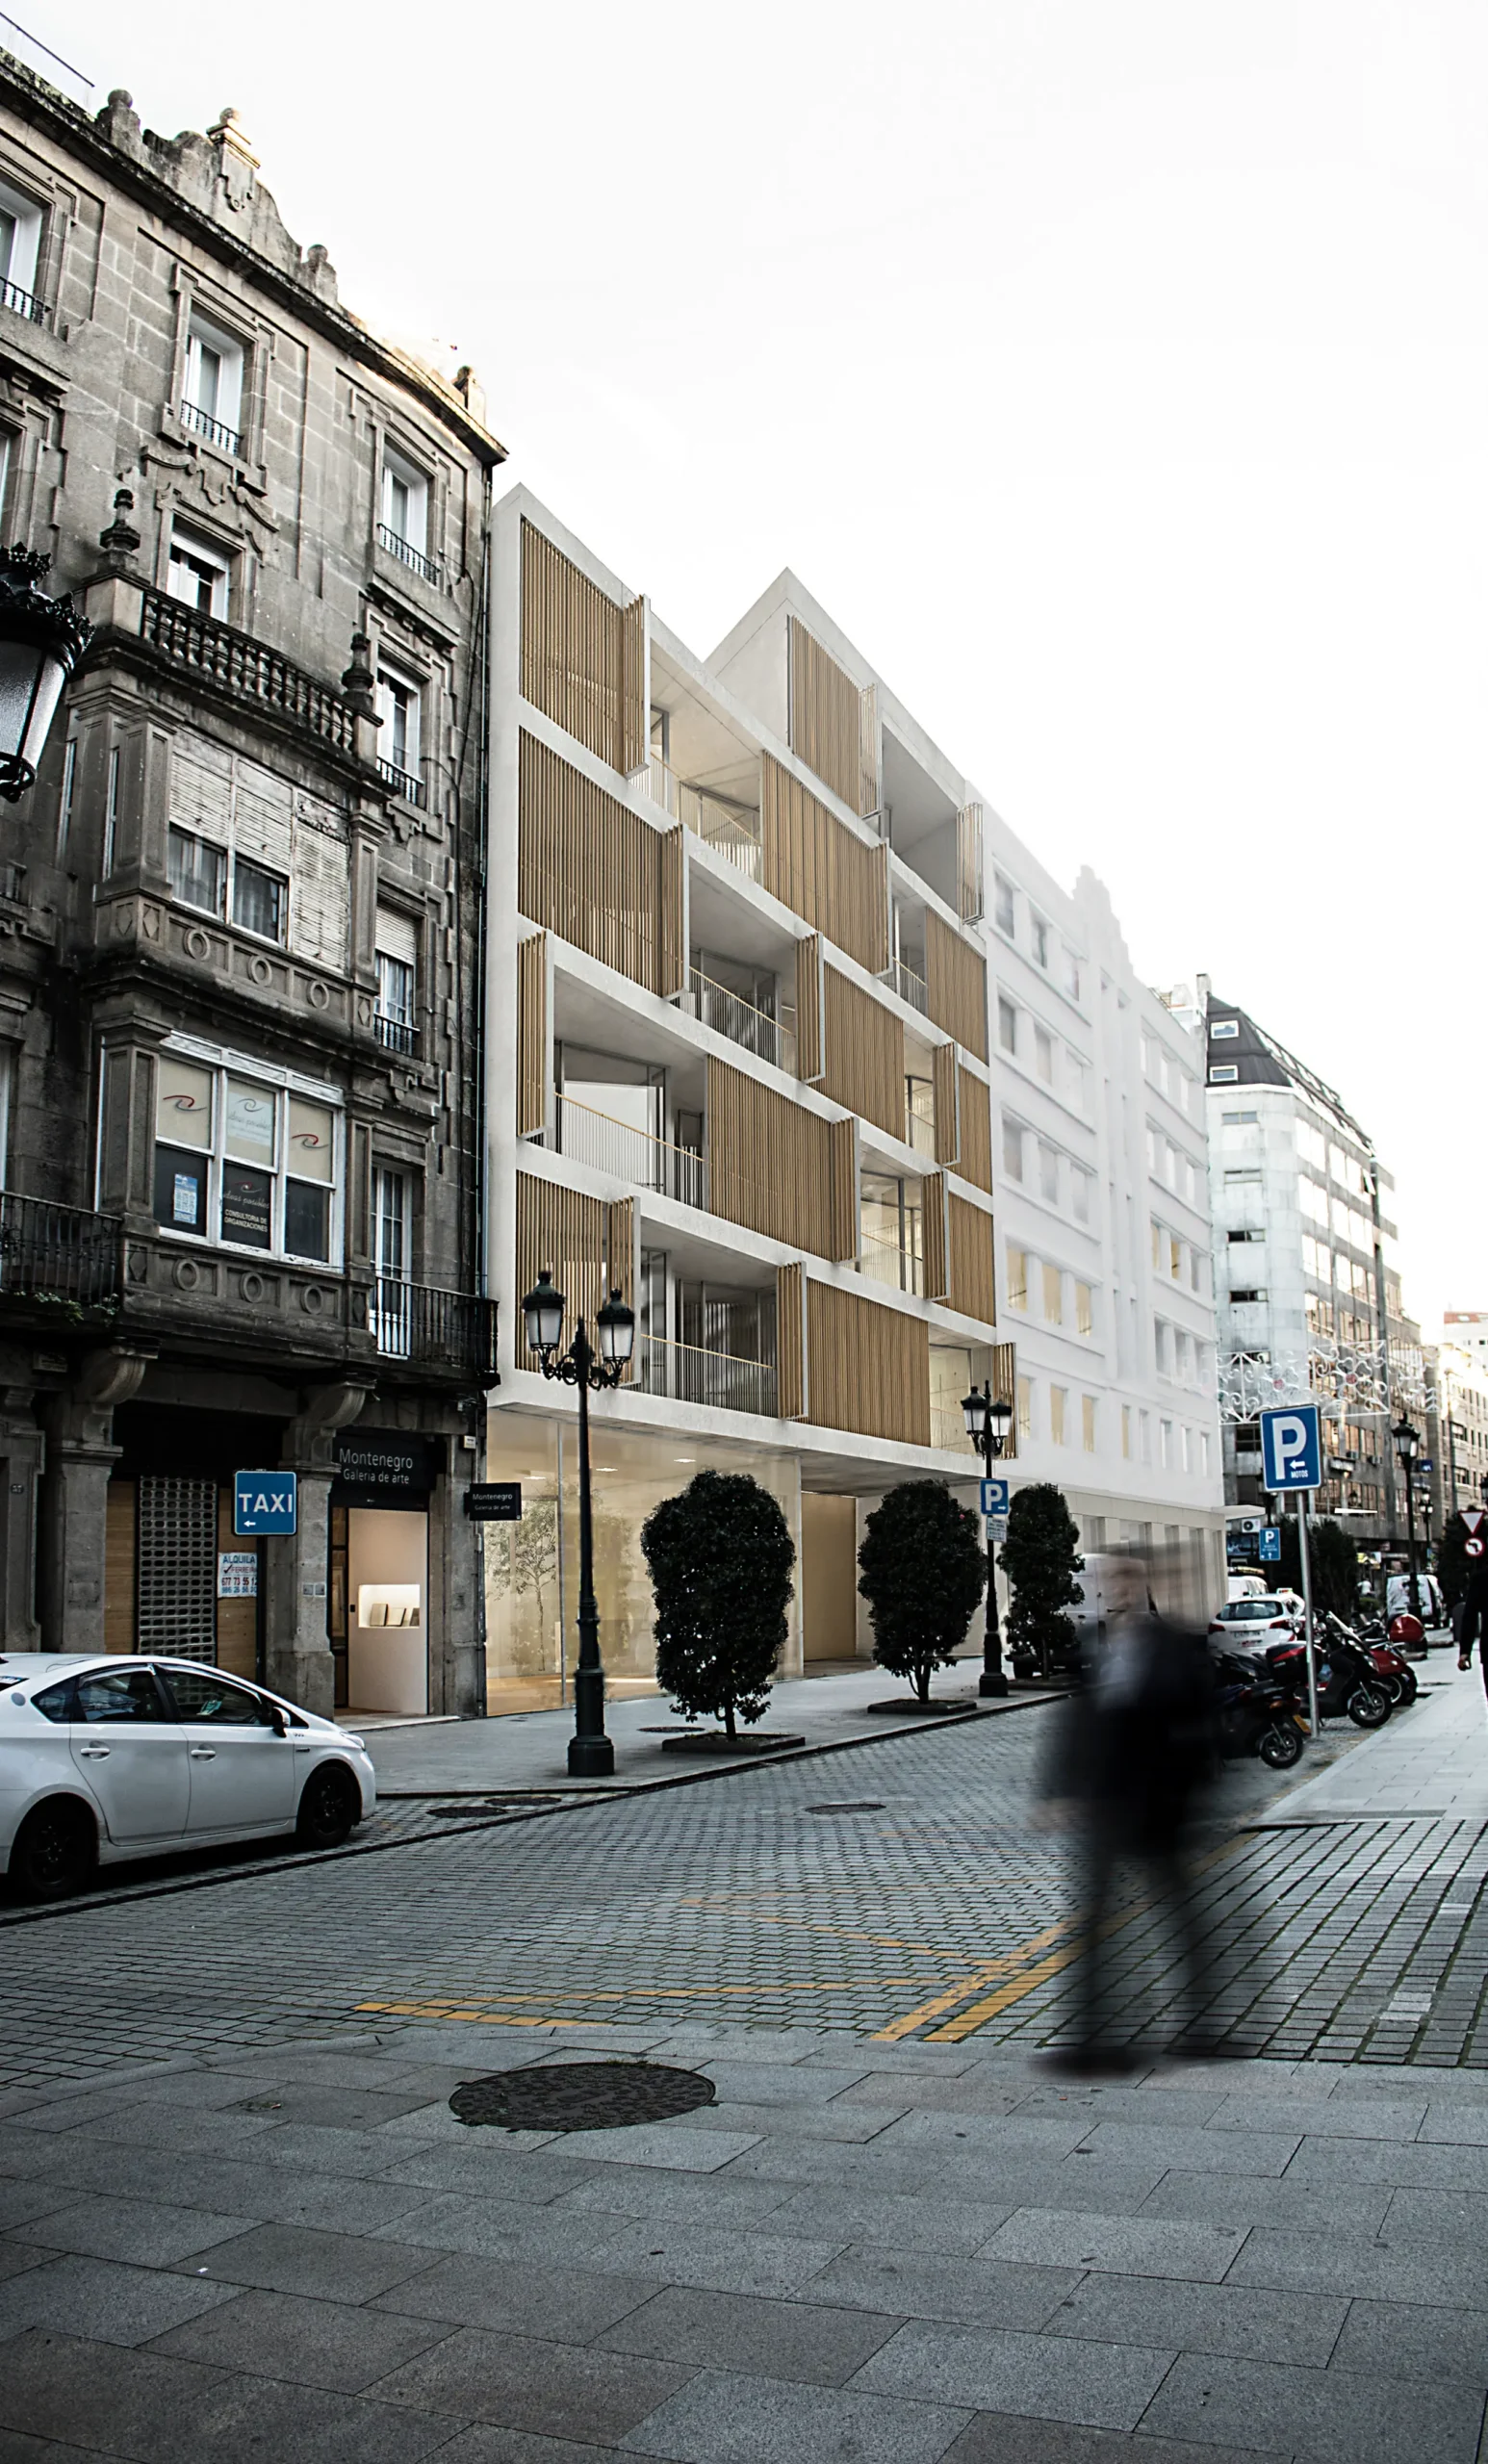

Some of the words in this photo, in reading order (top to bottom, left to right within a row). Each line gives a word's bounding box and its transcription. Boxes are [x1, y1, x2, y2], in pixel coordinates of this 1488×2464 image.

[224, 1217, 269, 1232] ORGANIZACIONES
[1271, 1416, 1307, 1480] P
[339, 1448, 413, 1472] Montenegro
[377, 1471, 390, 1483] de
[392, 1475, 410, 1484] arte
[1291, 1470, 1309, 1478] MOTOS
[238, 1493, 293, 1513] TAXI
[472, 1493, 513, 1502] Montenegro
[985, 1483, 1003, 1511] P
[1265, 1530, 1275, 1544] P
[222, 1554, 256, 1564] ALQUILA
